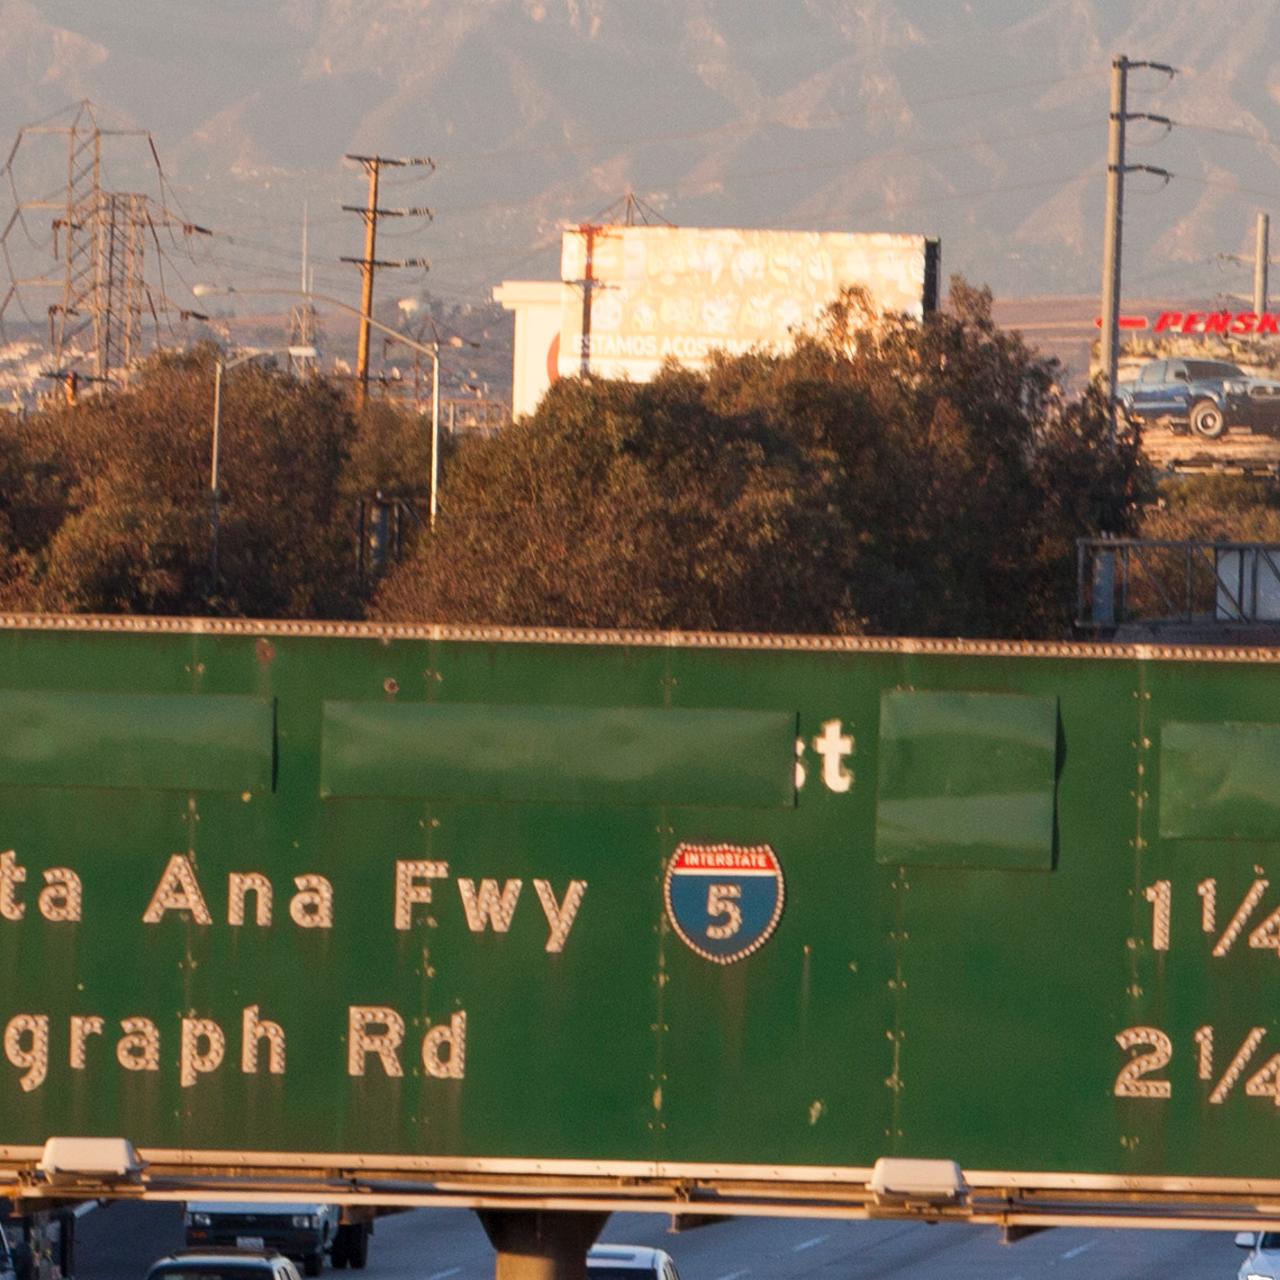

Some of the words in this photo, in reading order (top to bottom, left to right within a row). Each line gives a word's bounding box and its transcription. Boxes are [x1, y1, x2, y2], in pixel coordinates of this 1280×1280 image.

[0, 850, 83, 922] ta
[143, 853, 333, 928] Ana
[394, 859, 587, 953] Fwy
[706, 883, 742, 940] 5
[684, 853, 767, 868] INTERSTATE
[3, 1004, 286, 1092] graph
[348, 1005, 467, 1079] Rd
